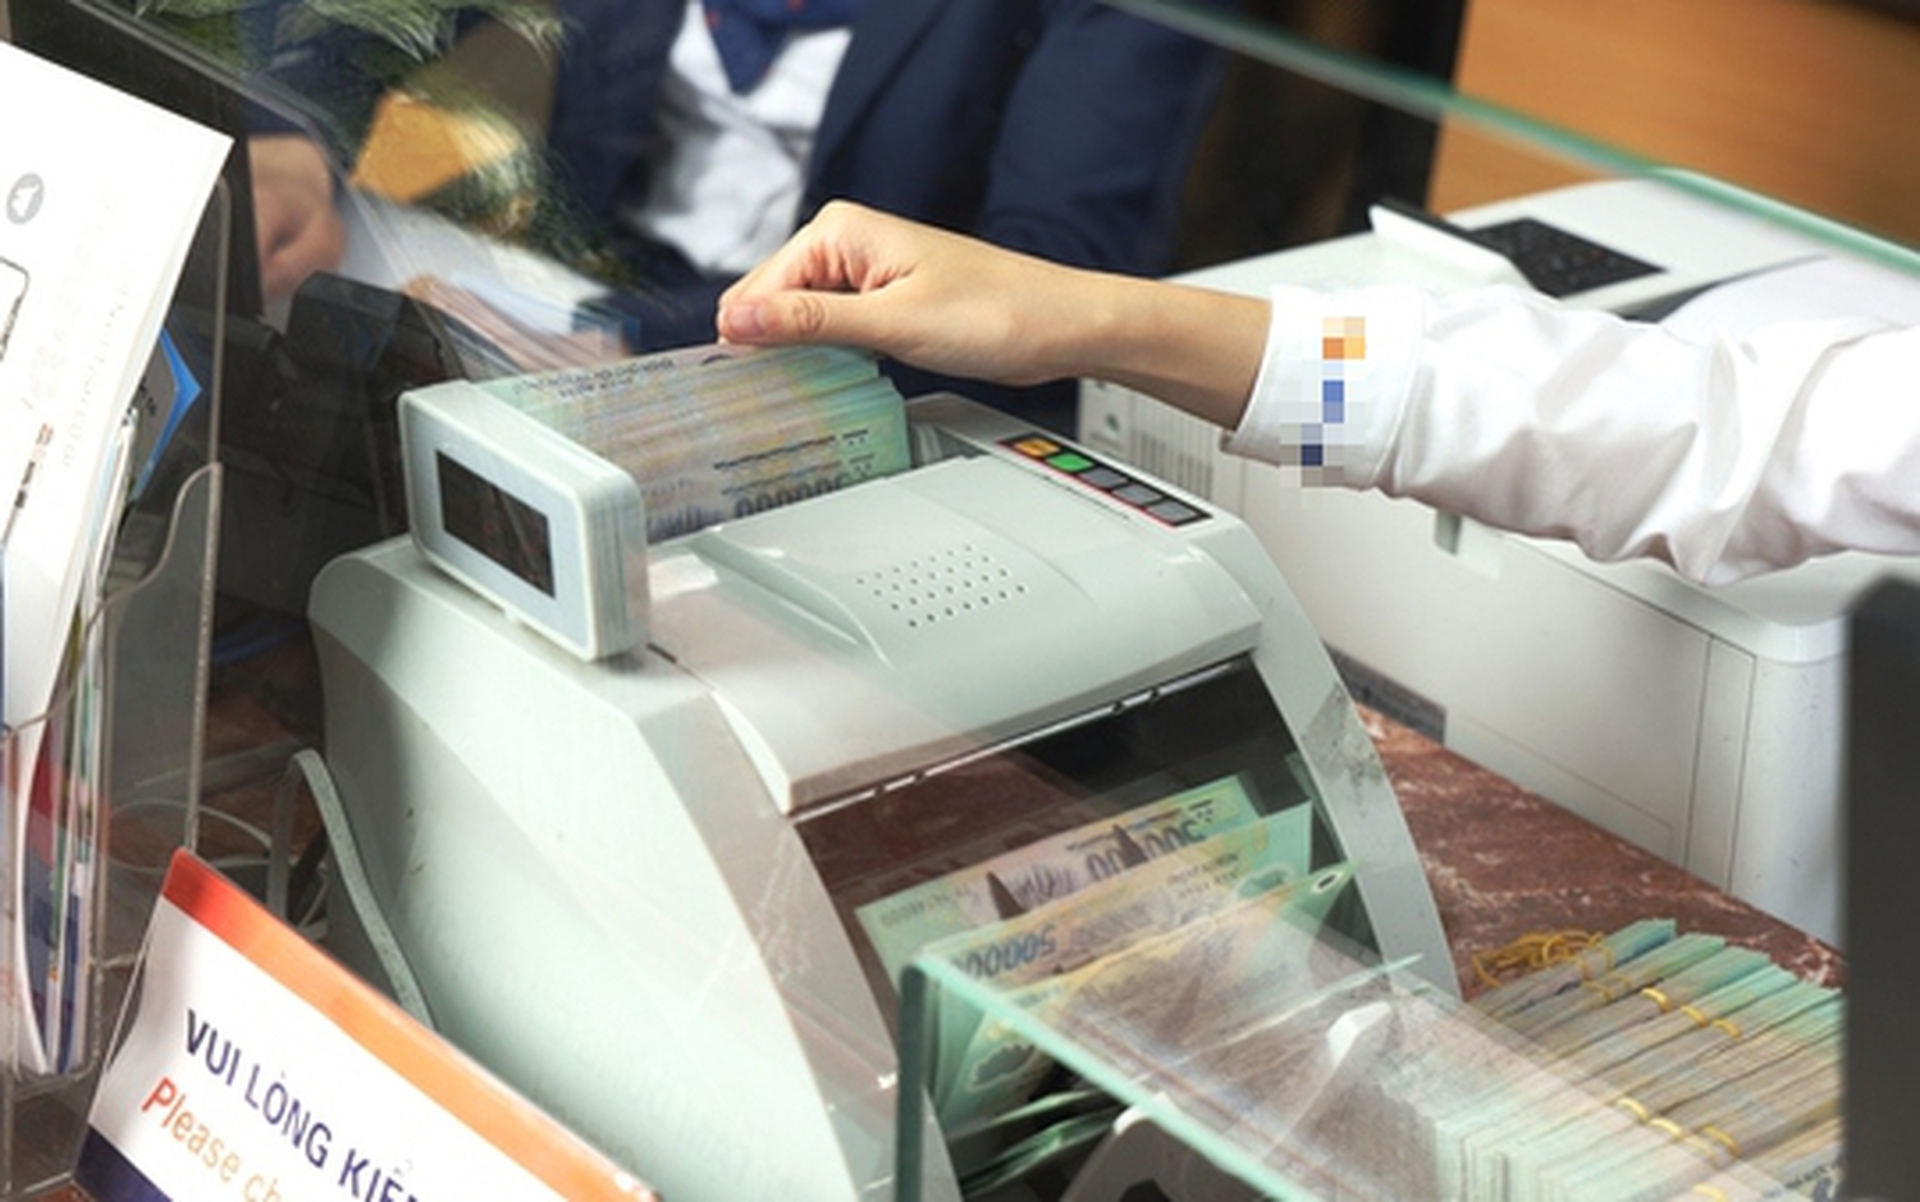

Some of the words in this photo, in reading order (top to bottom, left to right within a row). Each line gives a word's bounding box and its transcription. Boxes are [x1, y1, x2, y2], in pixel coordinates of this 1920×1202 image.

[141, 1076, 241, 1183] Please
[186, 1008, 241, 1087] VUI
[244, 1063, 333, 1169] LÒNG
